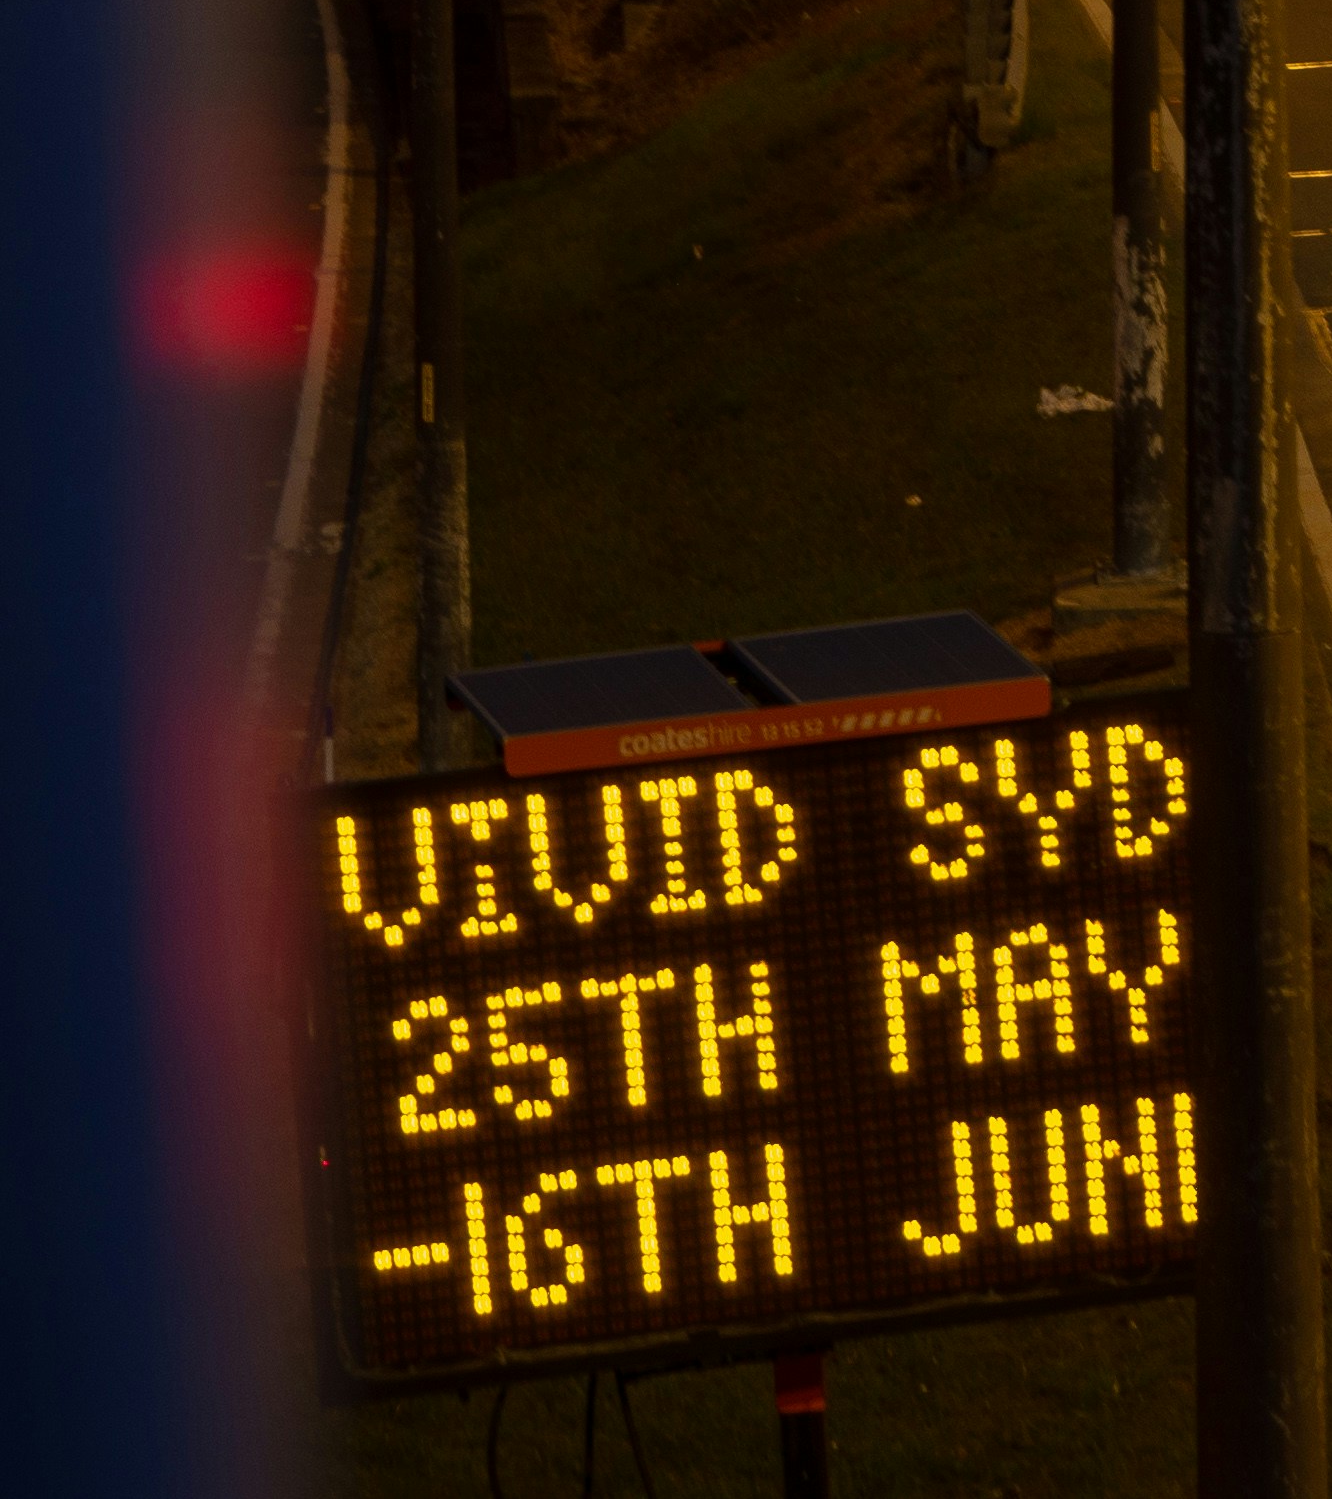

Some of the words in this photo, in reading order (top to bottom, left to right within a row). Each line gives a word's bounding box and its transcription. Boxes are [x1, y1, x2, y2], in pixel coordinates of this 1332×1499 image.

[902, 724, 1187, 881] SYD
[392, 961, 778, 1135] 25TH
[880, 909, 1180, 1074] MAY
[373, 1143, 793, 1316] -16TH
